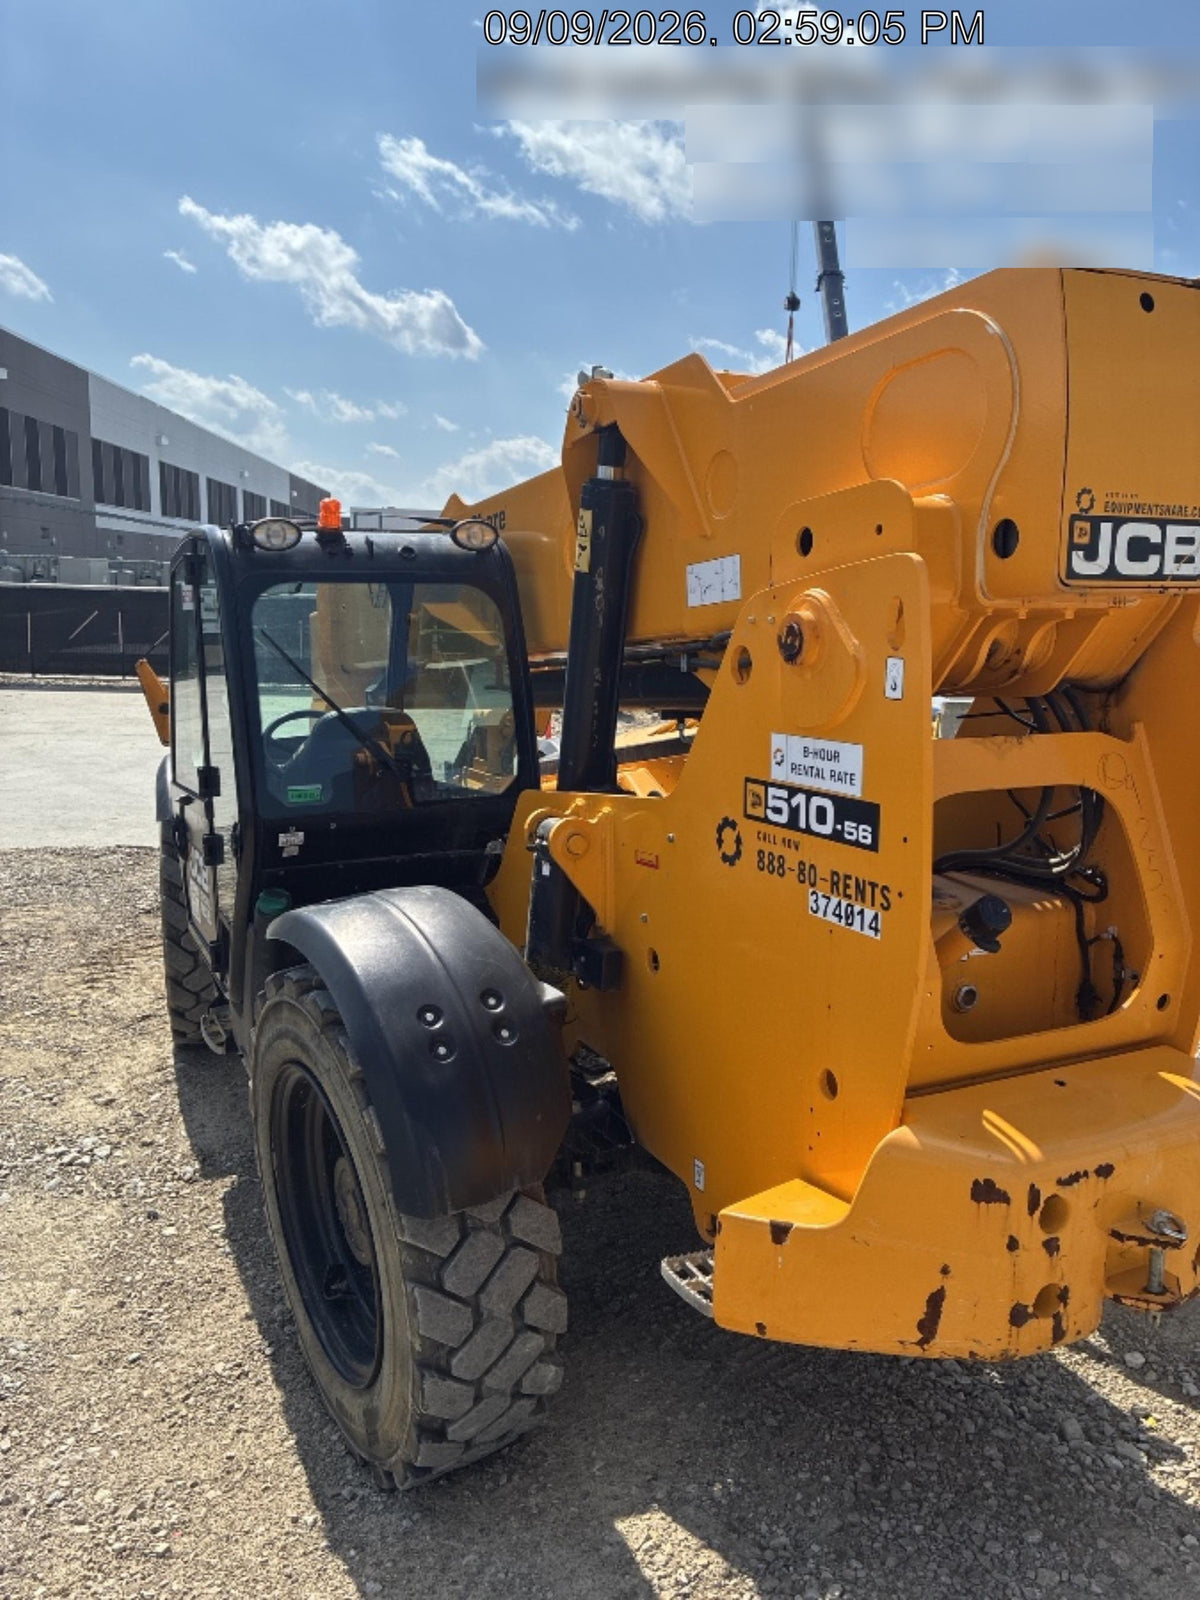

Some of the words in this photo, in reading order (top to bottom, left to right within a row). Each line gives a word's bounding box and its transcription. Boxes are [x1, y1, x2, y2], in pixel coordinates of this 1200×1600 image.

[1071, 522, 1200, 576] JCB
[790, 762, 825, 780] RENTAL
[829, 769, 856, 786] RATE
[756, 849, 892, 912] 888-80-RENTS
[809, 889, 881, 938] 374014
